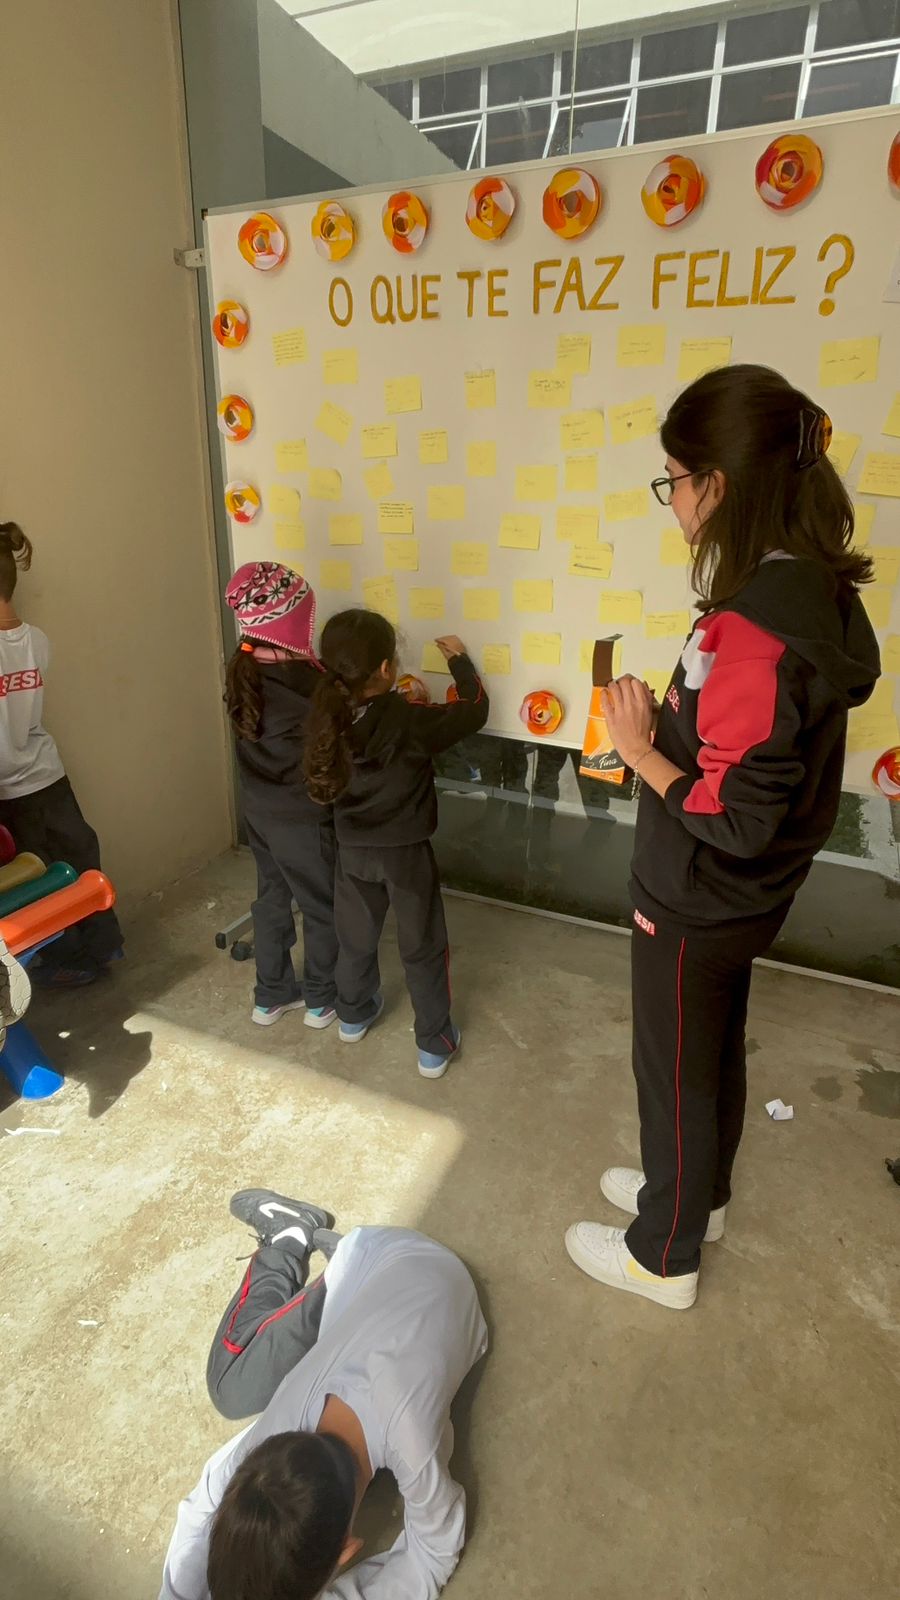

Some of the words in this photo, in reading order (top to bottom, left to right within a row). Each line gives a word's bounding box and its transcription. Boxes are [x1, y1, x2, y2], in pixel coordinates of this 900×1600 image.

[328, 278, 353, 328] O
[370, 274, 441, 324] QUE
[457, 269, 509, 317] TE
[533, 255, 625, 314] FAZ
[652, 246, 797, 310] FELIZ
[817, 234, 855, 317] ?
